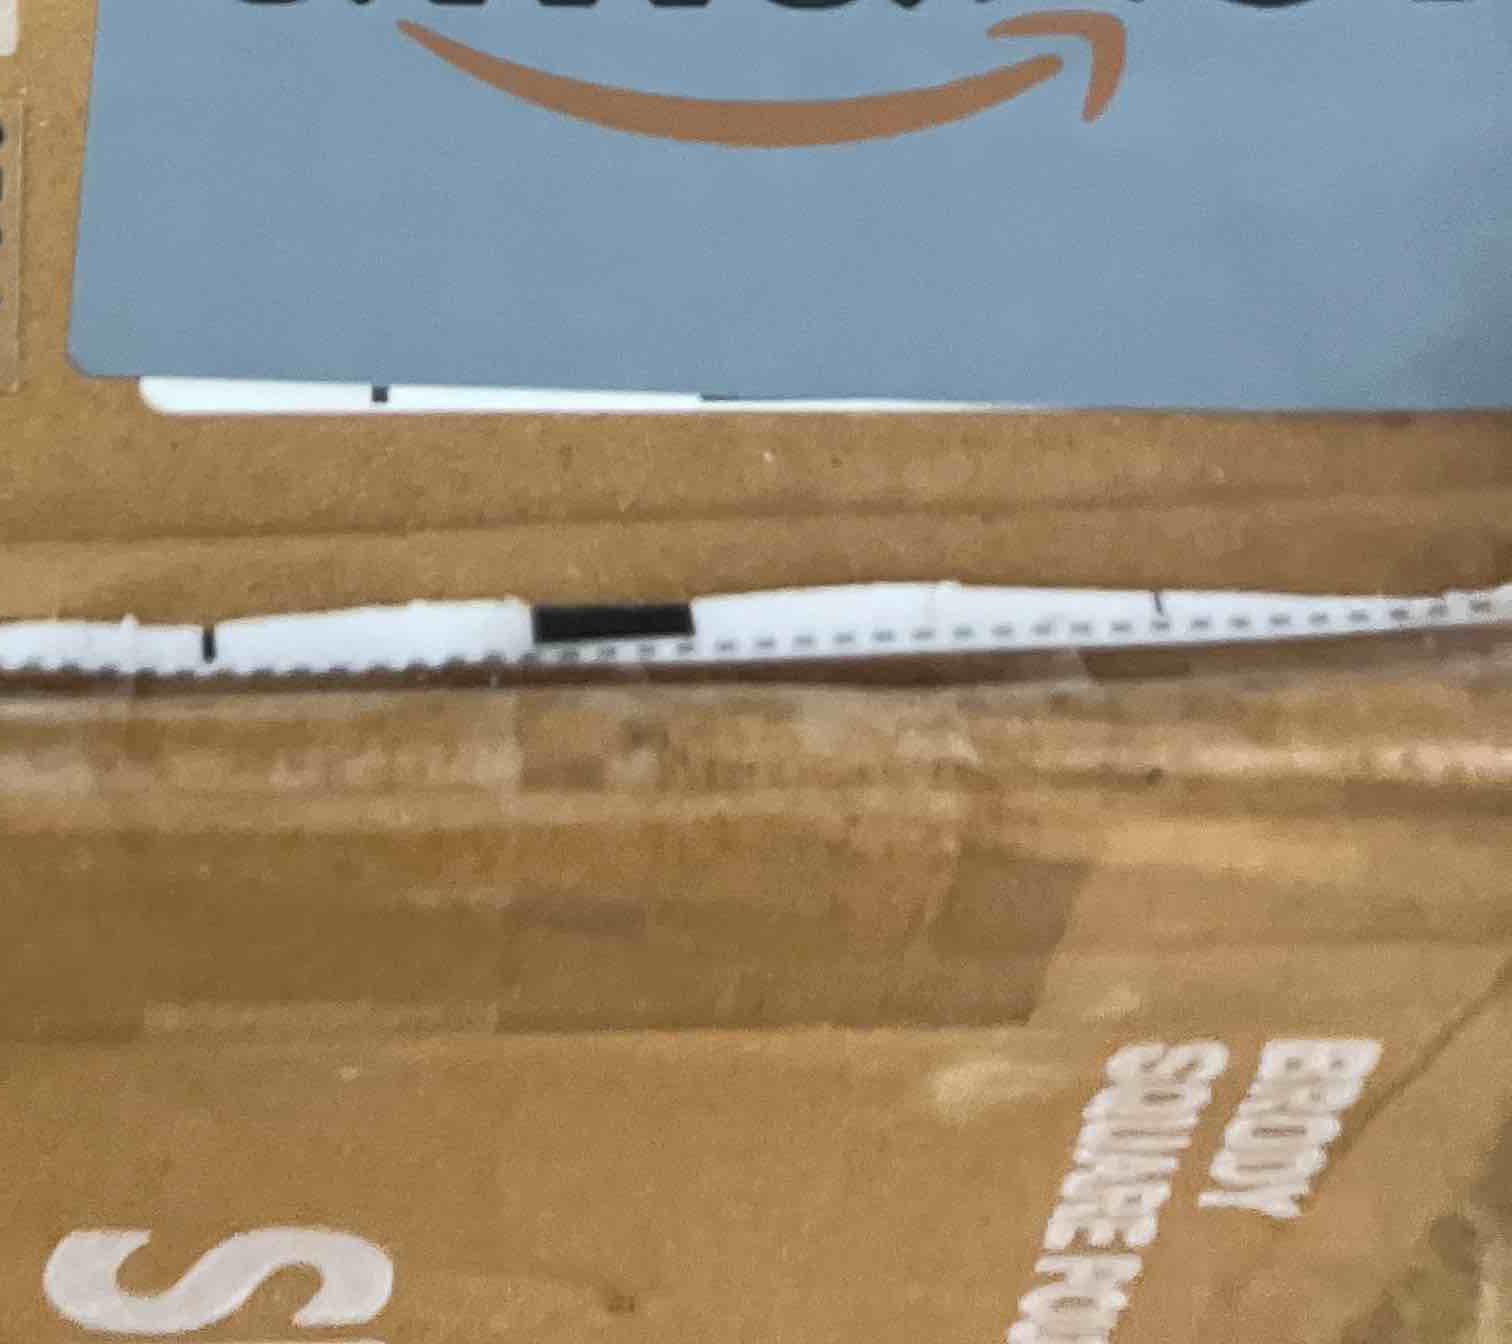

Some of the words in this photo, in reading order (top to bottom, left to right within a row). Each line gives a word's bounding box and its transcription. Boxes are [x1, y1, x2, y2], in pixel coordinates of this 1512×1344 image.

[1042, 1040, 1230, 1250] SQUARE
[1197, 1038, 1384, 1219] BRODY
[41, 1224, 394, 1344] S
